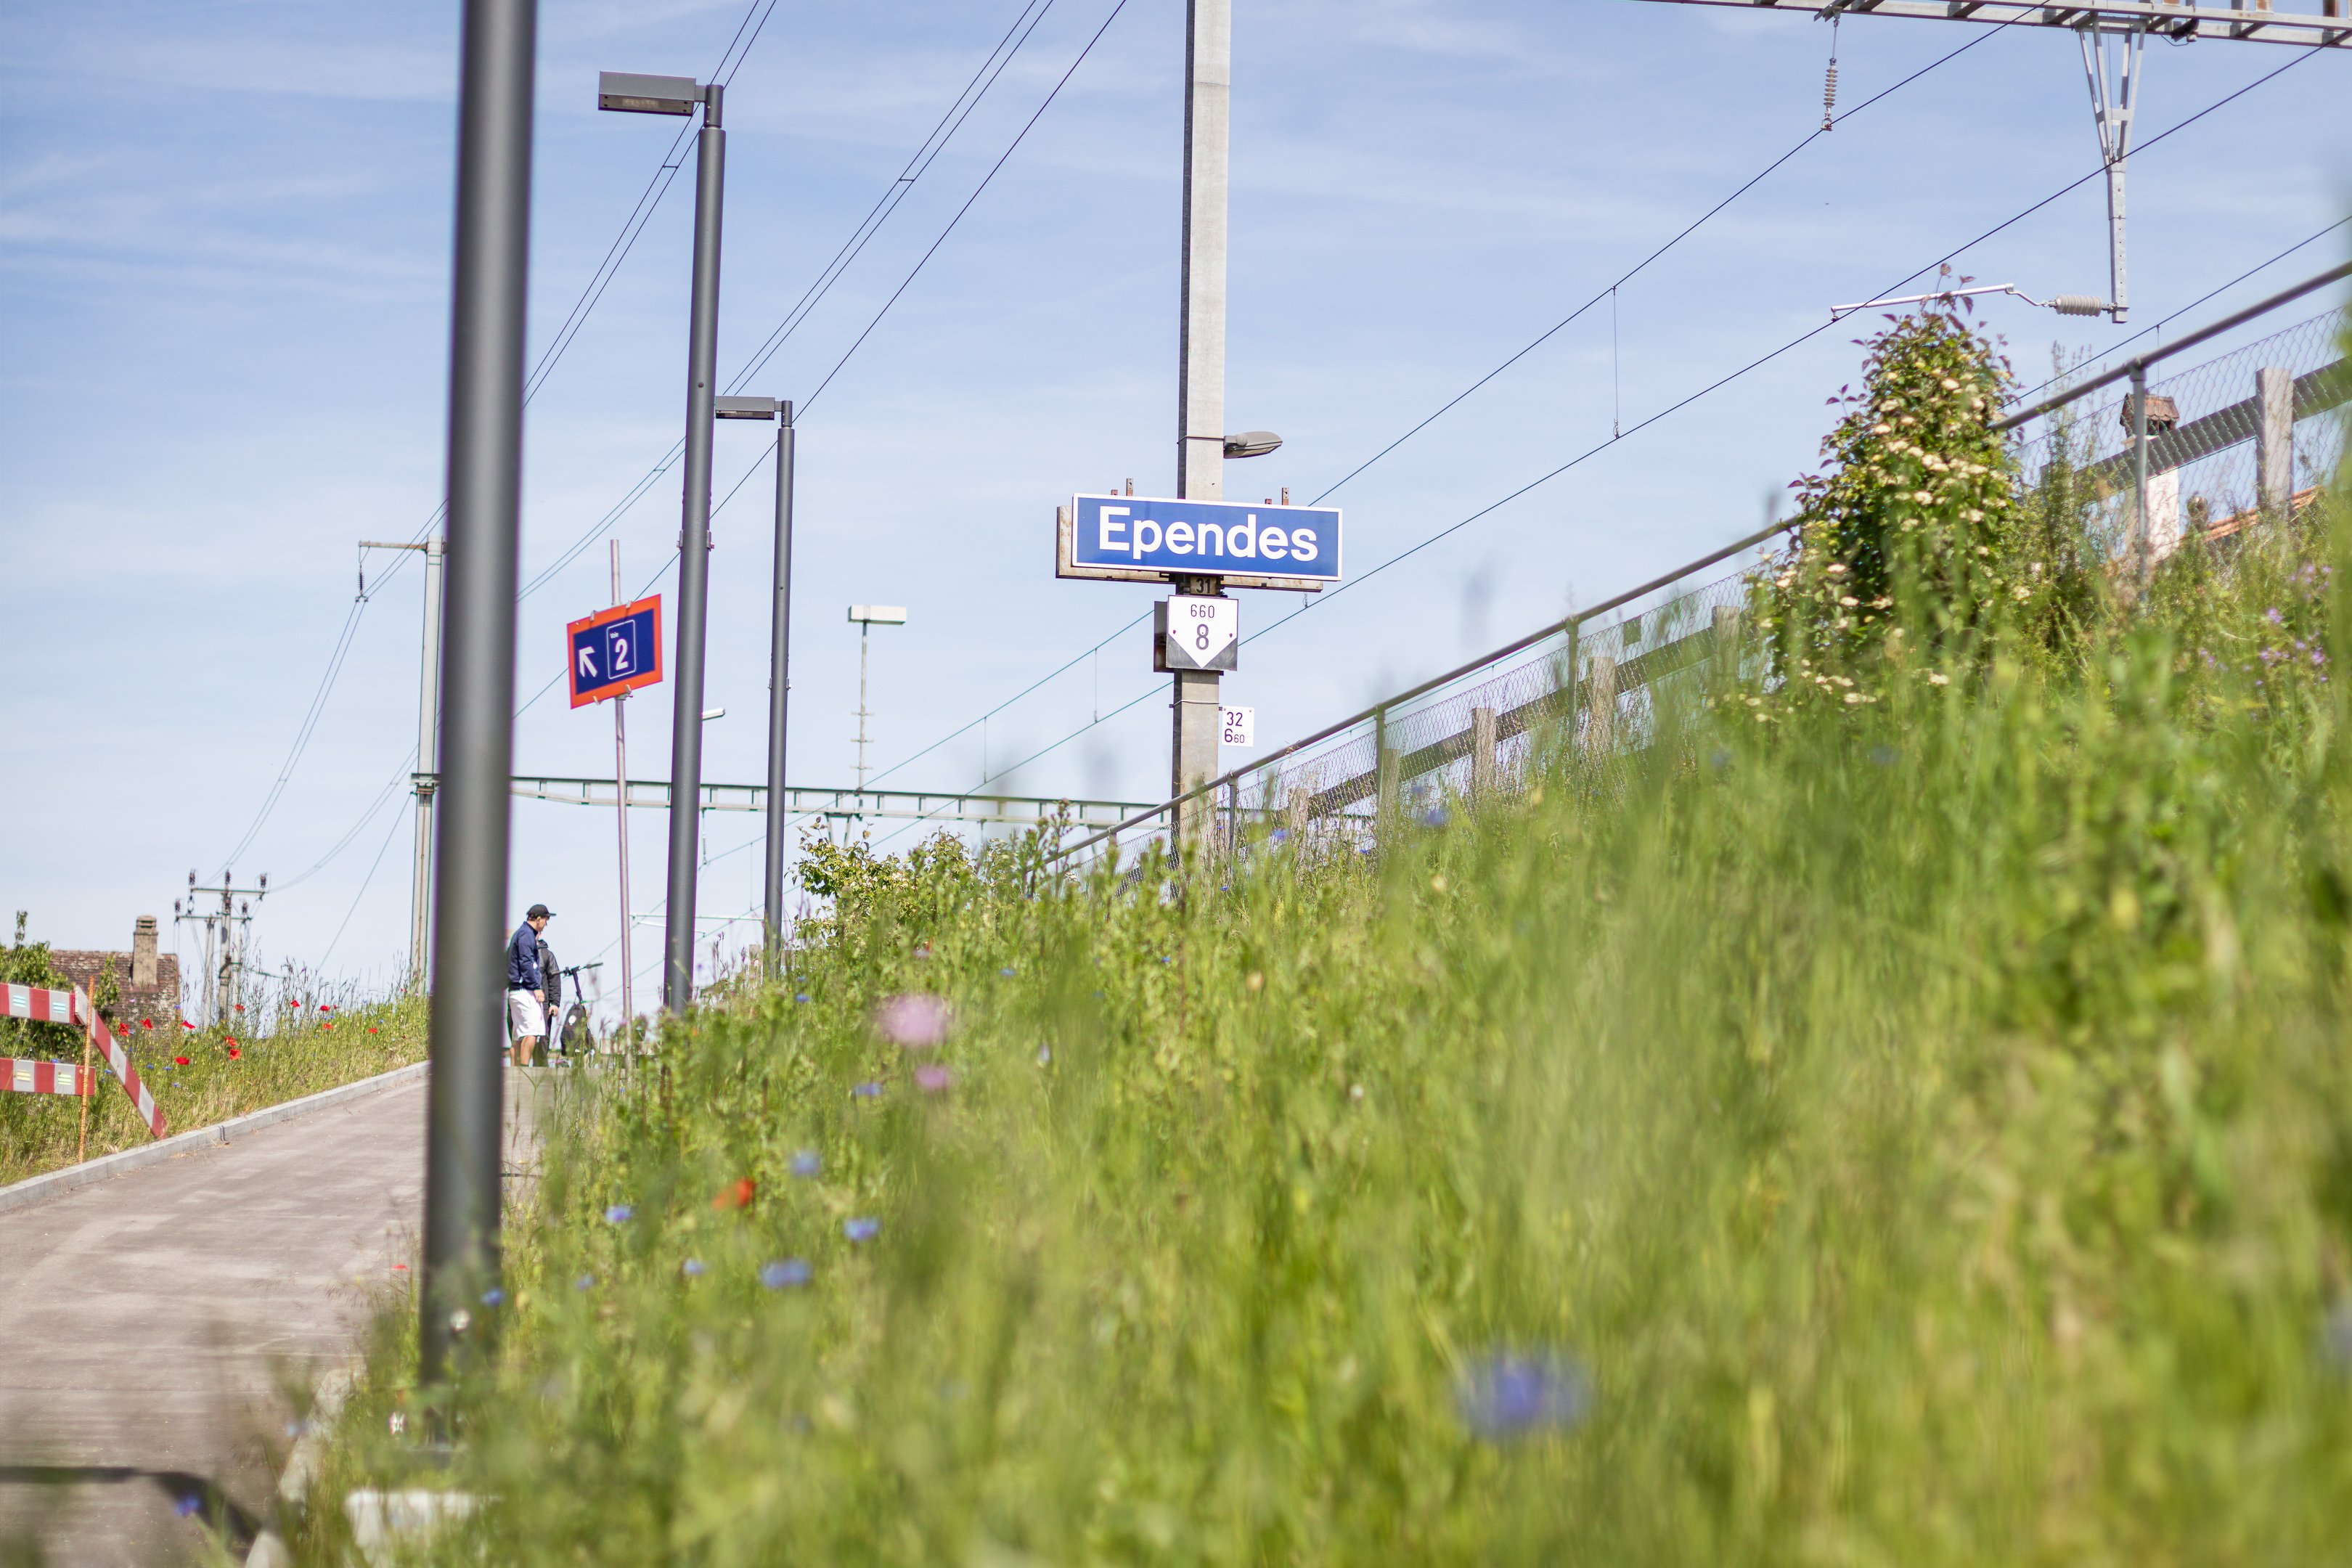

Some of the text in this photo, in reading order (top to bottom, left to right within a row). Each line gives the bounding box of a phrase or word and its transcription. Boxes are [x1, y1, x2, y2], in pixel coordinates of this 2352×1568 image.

[1099, 505, 1319, 562] Ependes
[1196, 578, 1211, 594] 31
[1191, 604, 1215, 618] 660
[1196, 624, 1209, 650] 8
[615, 638, 628, 671] 2
[1226, 711, 1243, 727] 32
